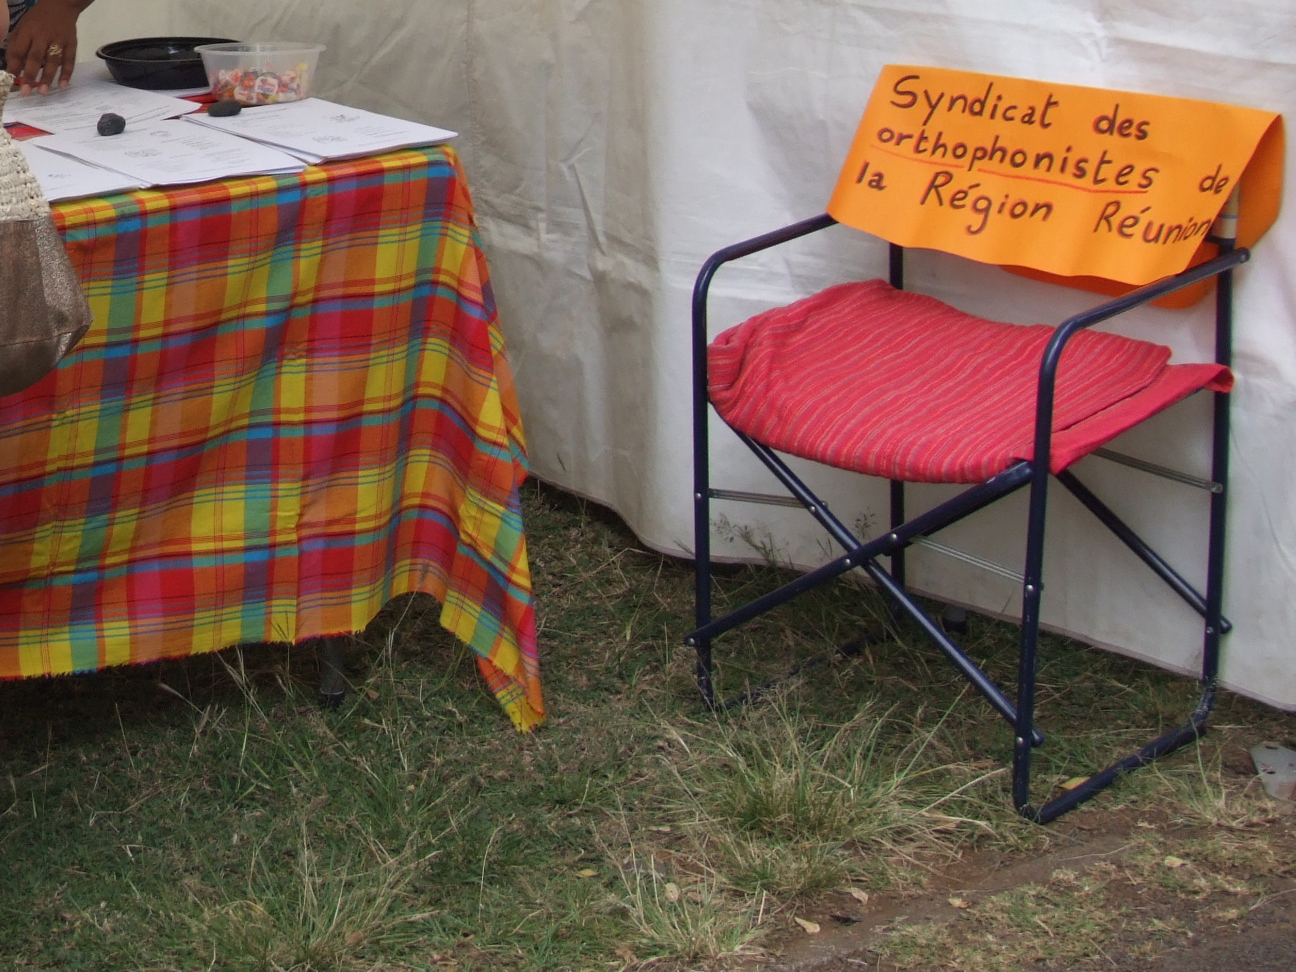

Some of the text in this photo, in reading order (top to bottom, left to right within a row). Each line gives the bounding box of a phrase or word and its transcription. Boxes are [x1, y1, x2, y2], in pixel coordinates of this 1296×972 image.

[890, 74, 1151, 140] Syndicat des
[877, 126, 1229, 196] orthophonistes de
[856, 161, 887, 190] la
[920, 170, 1053, 235] Région
